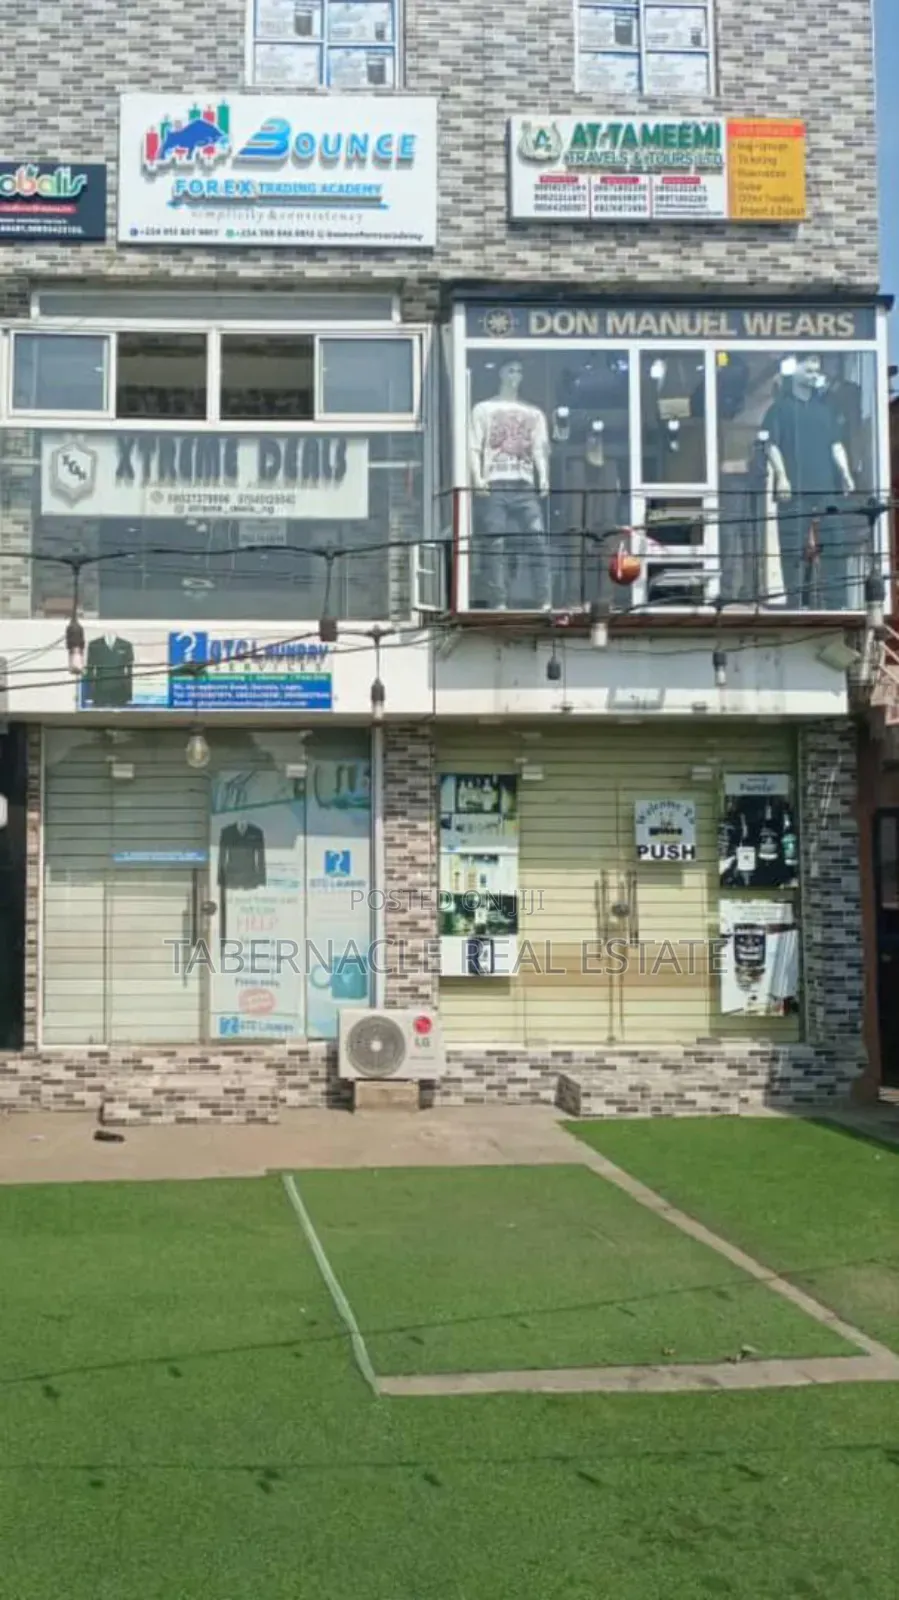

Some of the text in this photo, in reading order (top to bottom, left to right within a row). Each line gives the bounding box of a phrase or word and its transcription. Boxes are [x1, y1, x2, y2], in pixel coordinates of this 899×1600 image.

[240, 117, 417, 158] BOUNCE
[568, 151, 628, 165] TRAVELS
[648, 151, 692, 165] TOURS
[174, 178, 382, 195] FOREX TRADING ACADEMY
[529, 311, 856, 337] DON MANUEL WEARS
[115, 436, 348, 482] XTREME DEALS
[636, 844, 695, 860] PUSH
[414, 1036, 431, 1048] LG
